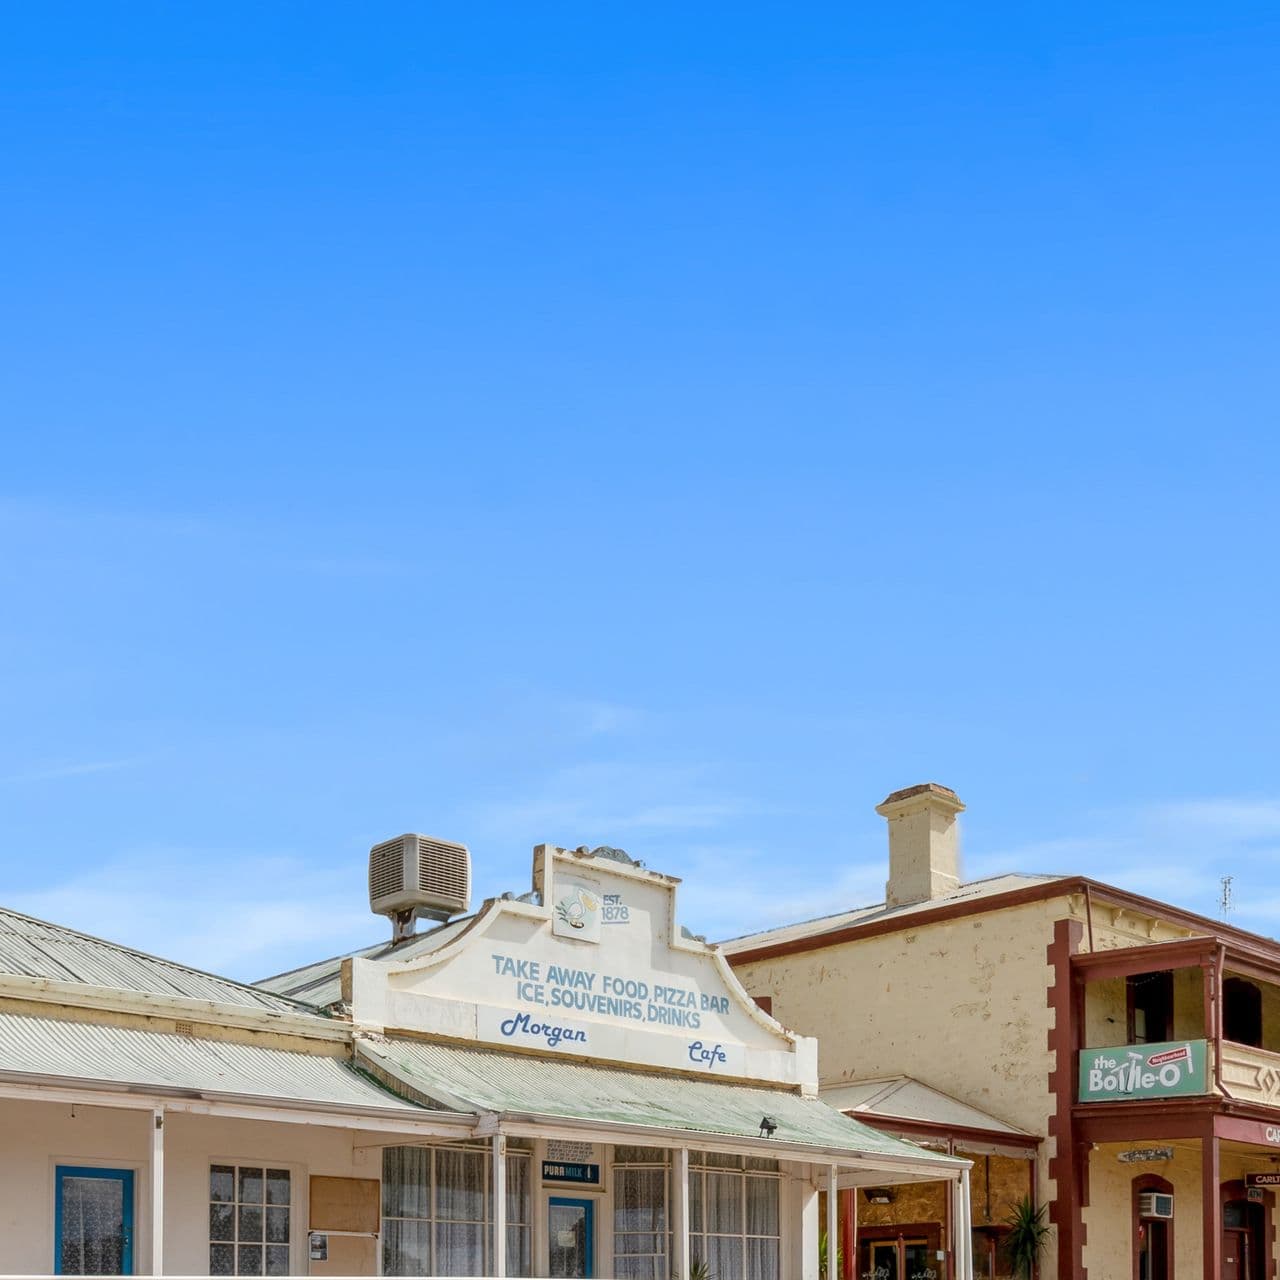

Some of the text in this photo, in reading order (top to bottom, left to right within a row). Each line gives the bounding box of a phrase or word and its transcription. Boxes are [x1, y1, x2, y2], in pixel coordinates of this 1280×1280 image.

[603, 894, 622, 906] EST.
[601, 907, 629, 921] 1878
[491, 954, 540, 982] TAKE
[546, 965, 596, 991] AWAY
[700, 993, 730, 1015] BAR
[500, 1012, 587, 1047] Morgan
[688, 1041, 727, 1068] Cafe
[1094, 1055, 1116, 1069] the
[544, 1165, 565, 1177] PURA
